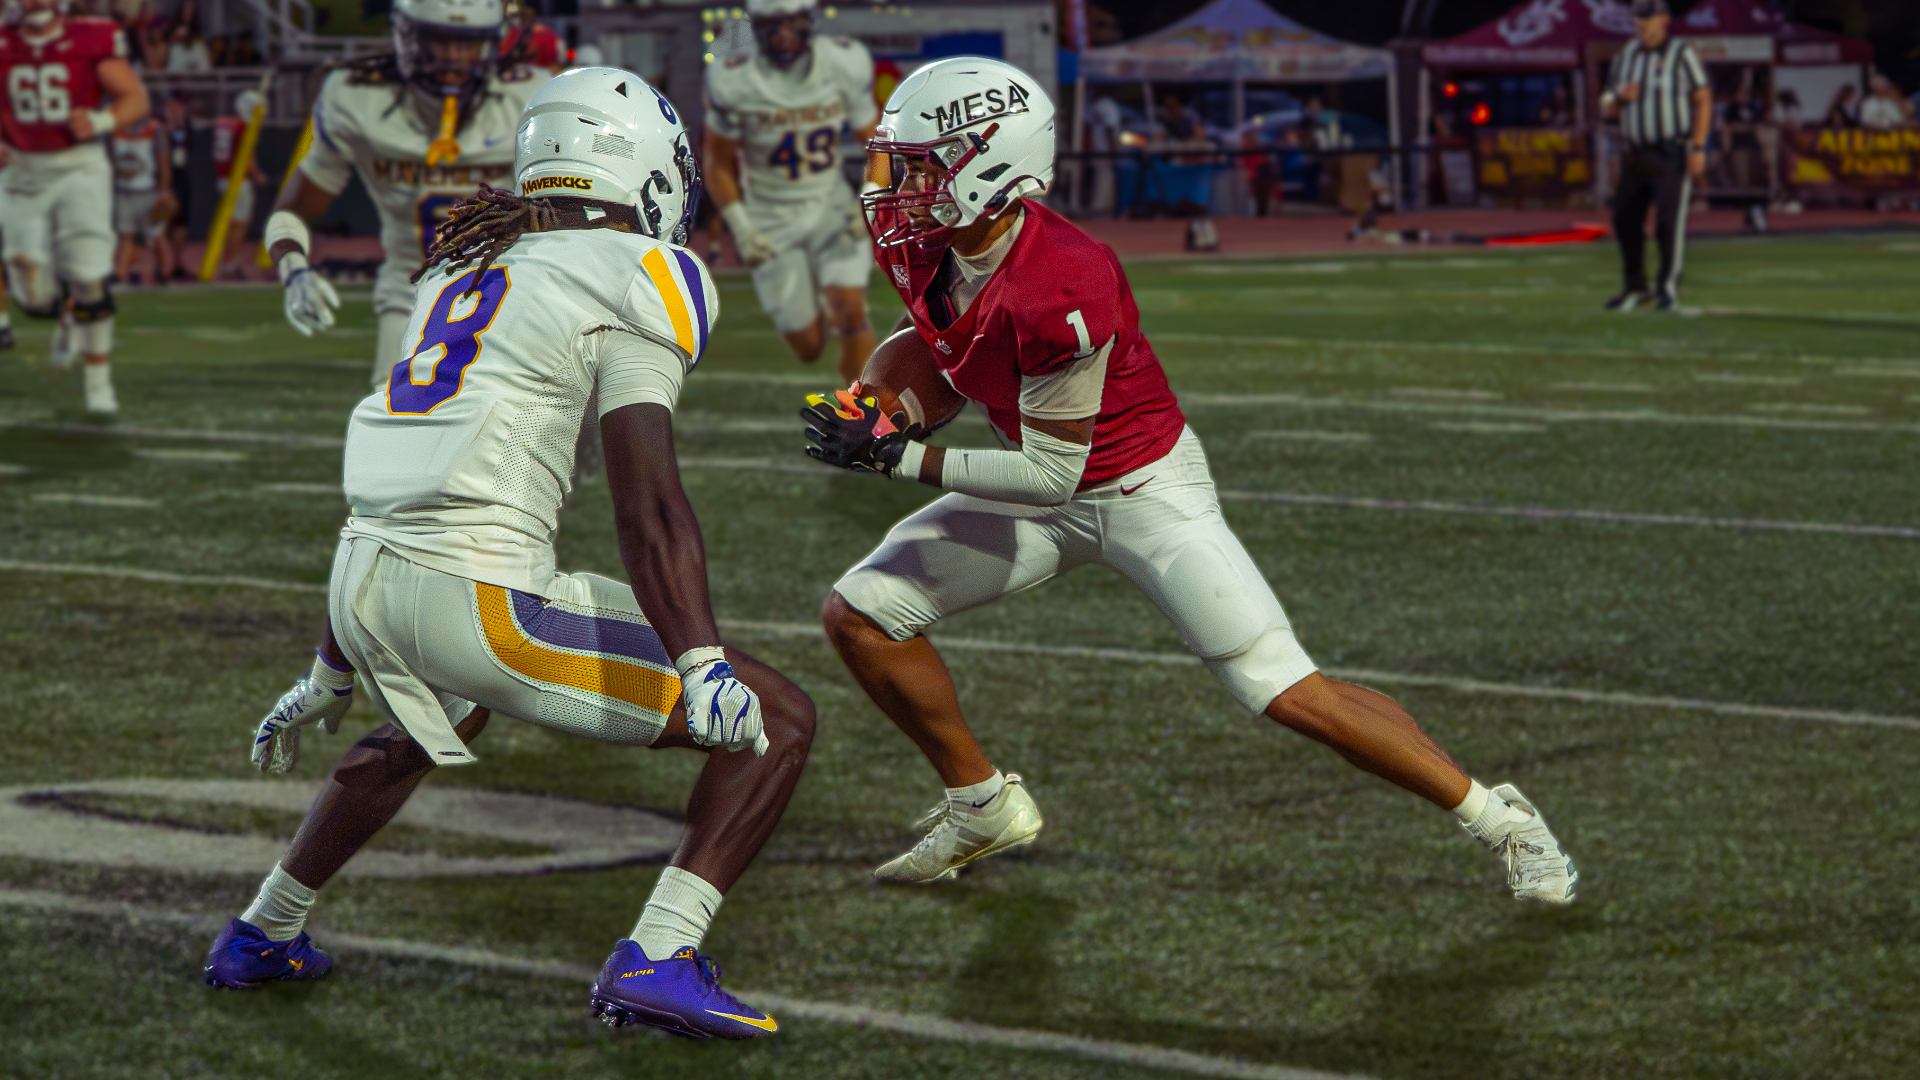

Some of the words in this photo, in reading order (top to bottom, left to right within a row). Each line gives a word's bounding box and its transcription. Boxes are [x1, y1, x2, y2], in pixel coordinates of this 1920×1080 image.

[8, 63, 71, 124] 66
[934, 84, 1029, 134] MESA
[768, 124, 836, 182] 49
[520, 176, 594, 196] MAVERICKS
[386, 265, 512, 416] 8
[1065, 309, 1095, 358] 1
